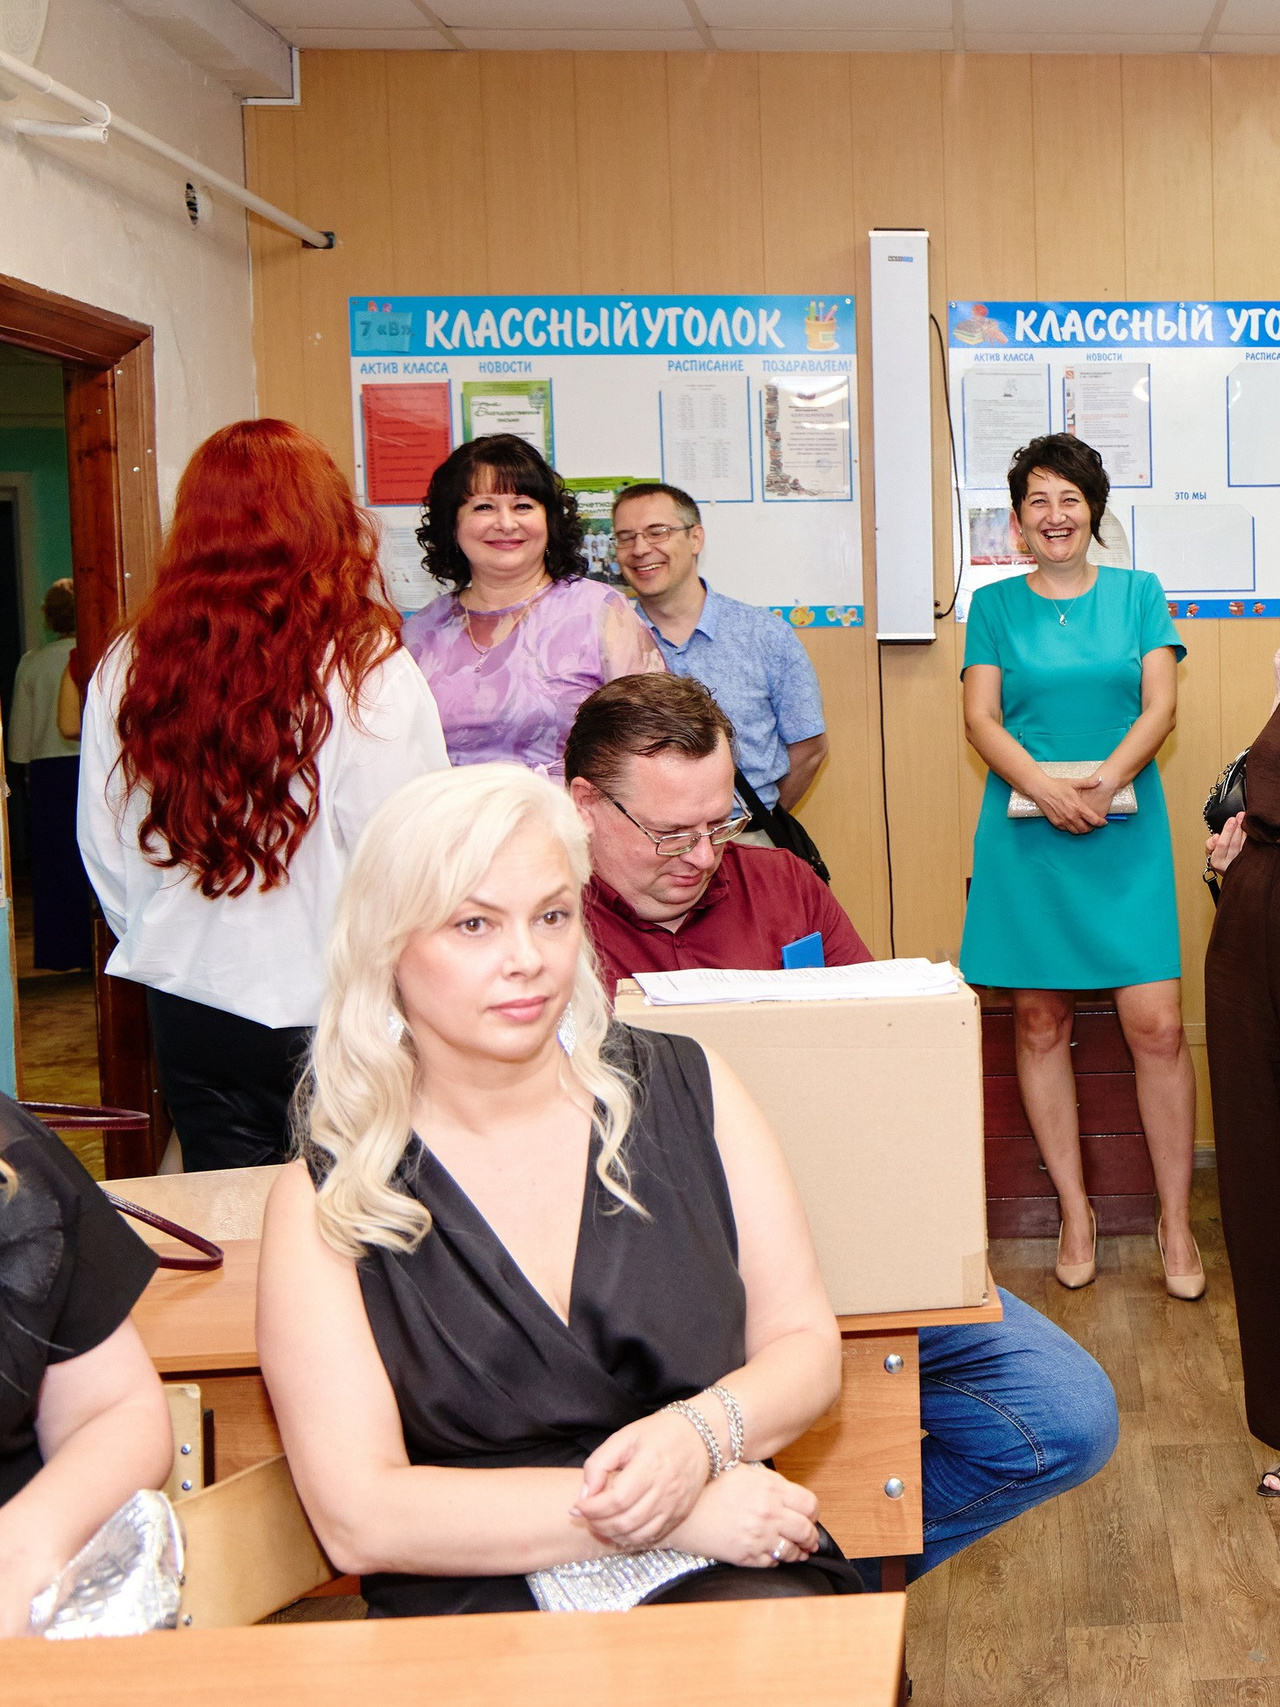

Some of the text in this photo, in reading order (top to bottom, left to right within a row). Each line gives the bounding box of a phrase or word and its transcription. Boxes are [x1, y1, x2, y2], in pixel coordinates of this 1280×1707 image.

[360, 320, 371, 336] 7
[425, 301, 785, 350] КЛАССНЫЙ УГОЛОК
[1015, 303, 1214, 343] КЛАССНЫЙ
[974, 353, 1035, 362] АКТИВ КЛАССА
[1086, 353, 1123, 362] НОВОСТИ
[360, 361, 449, 375] АКТИВ КЛАССА
[478, 361, 532, 373] НОВОСТИ
[667, 359, 745, 372] РАСПИСАНИЕ
[762, 359, 852, 373] ПОЗДРАВЛЯЕМ!
[1174, 491, 1207, 501] ЭТО МЫ
